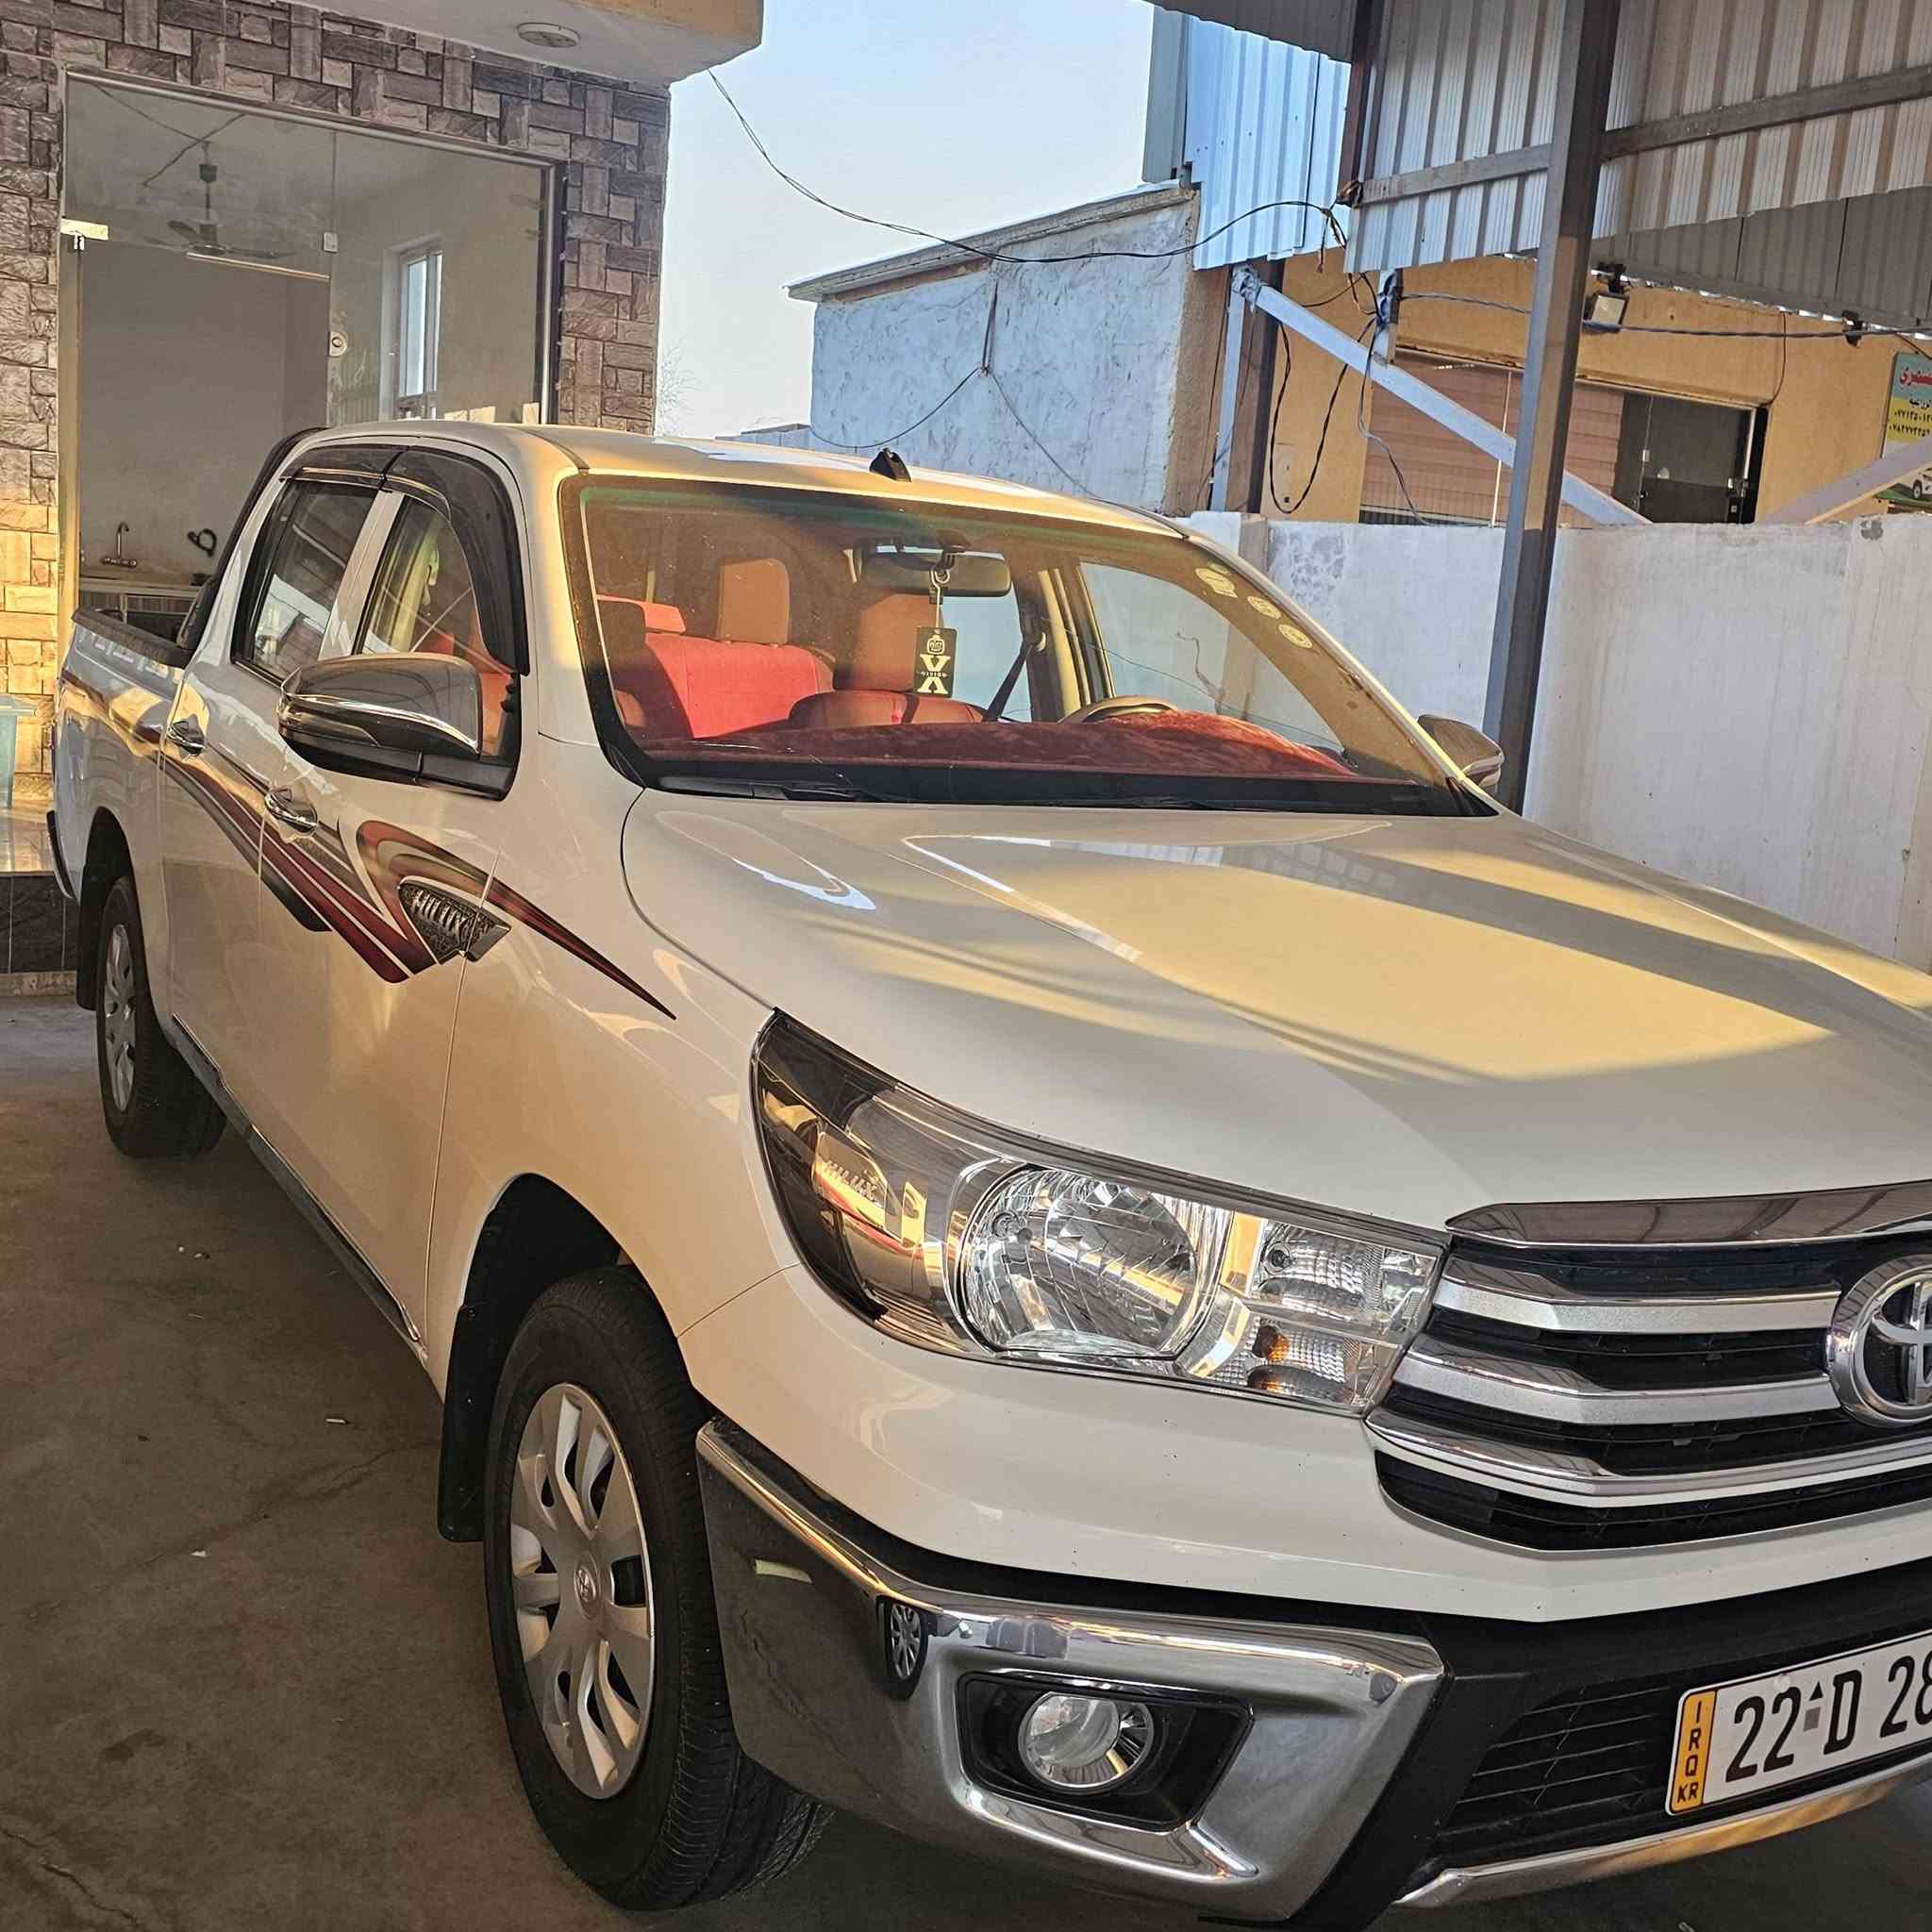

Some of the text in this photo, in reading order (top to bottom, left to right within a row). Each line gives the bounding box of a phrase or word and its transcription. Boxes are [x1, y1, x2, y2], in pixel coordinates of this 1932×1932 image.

[1724, 1686, 1802, 1783] 22
[1823, 1669, 1863, 1756] D
[1676, 1781, 1699, 1804] KR
